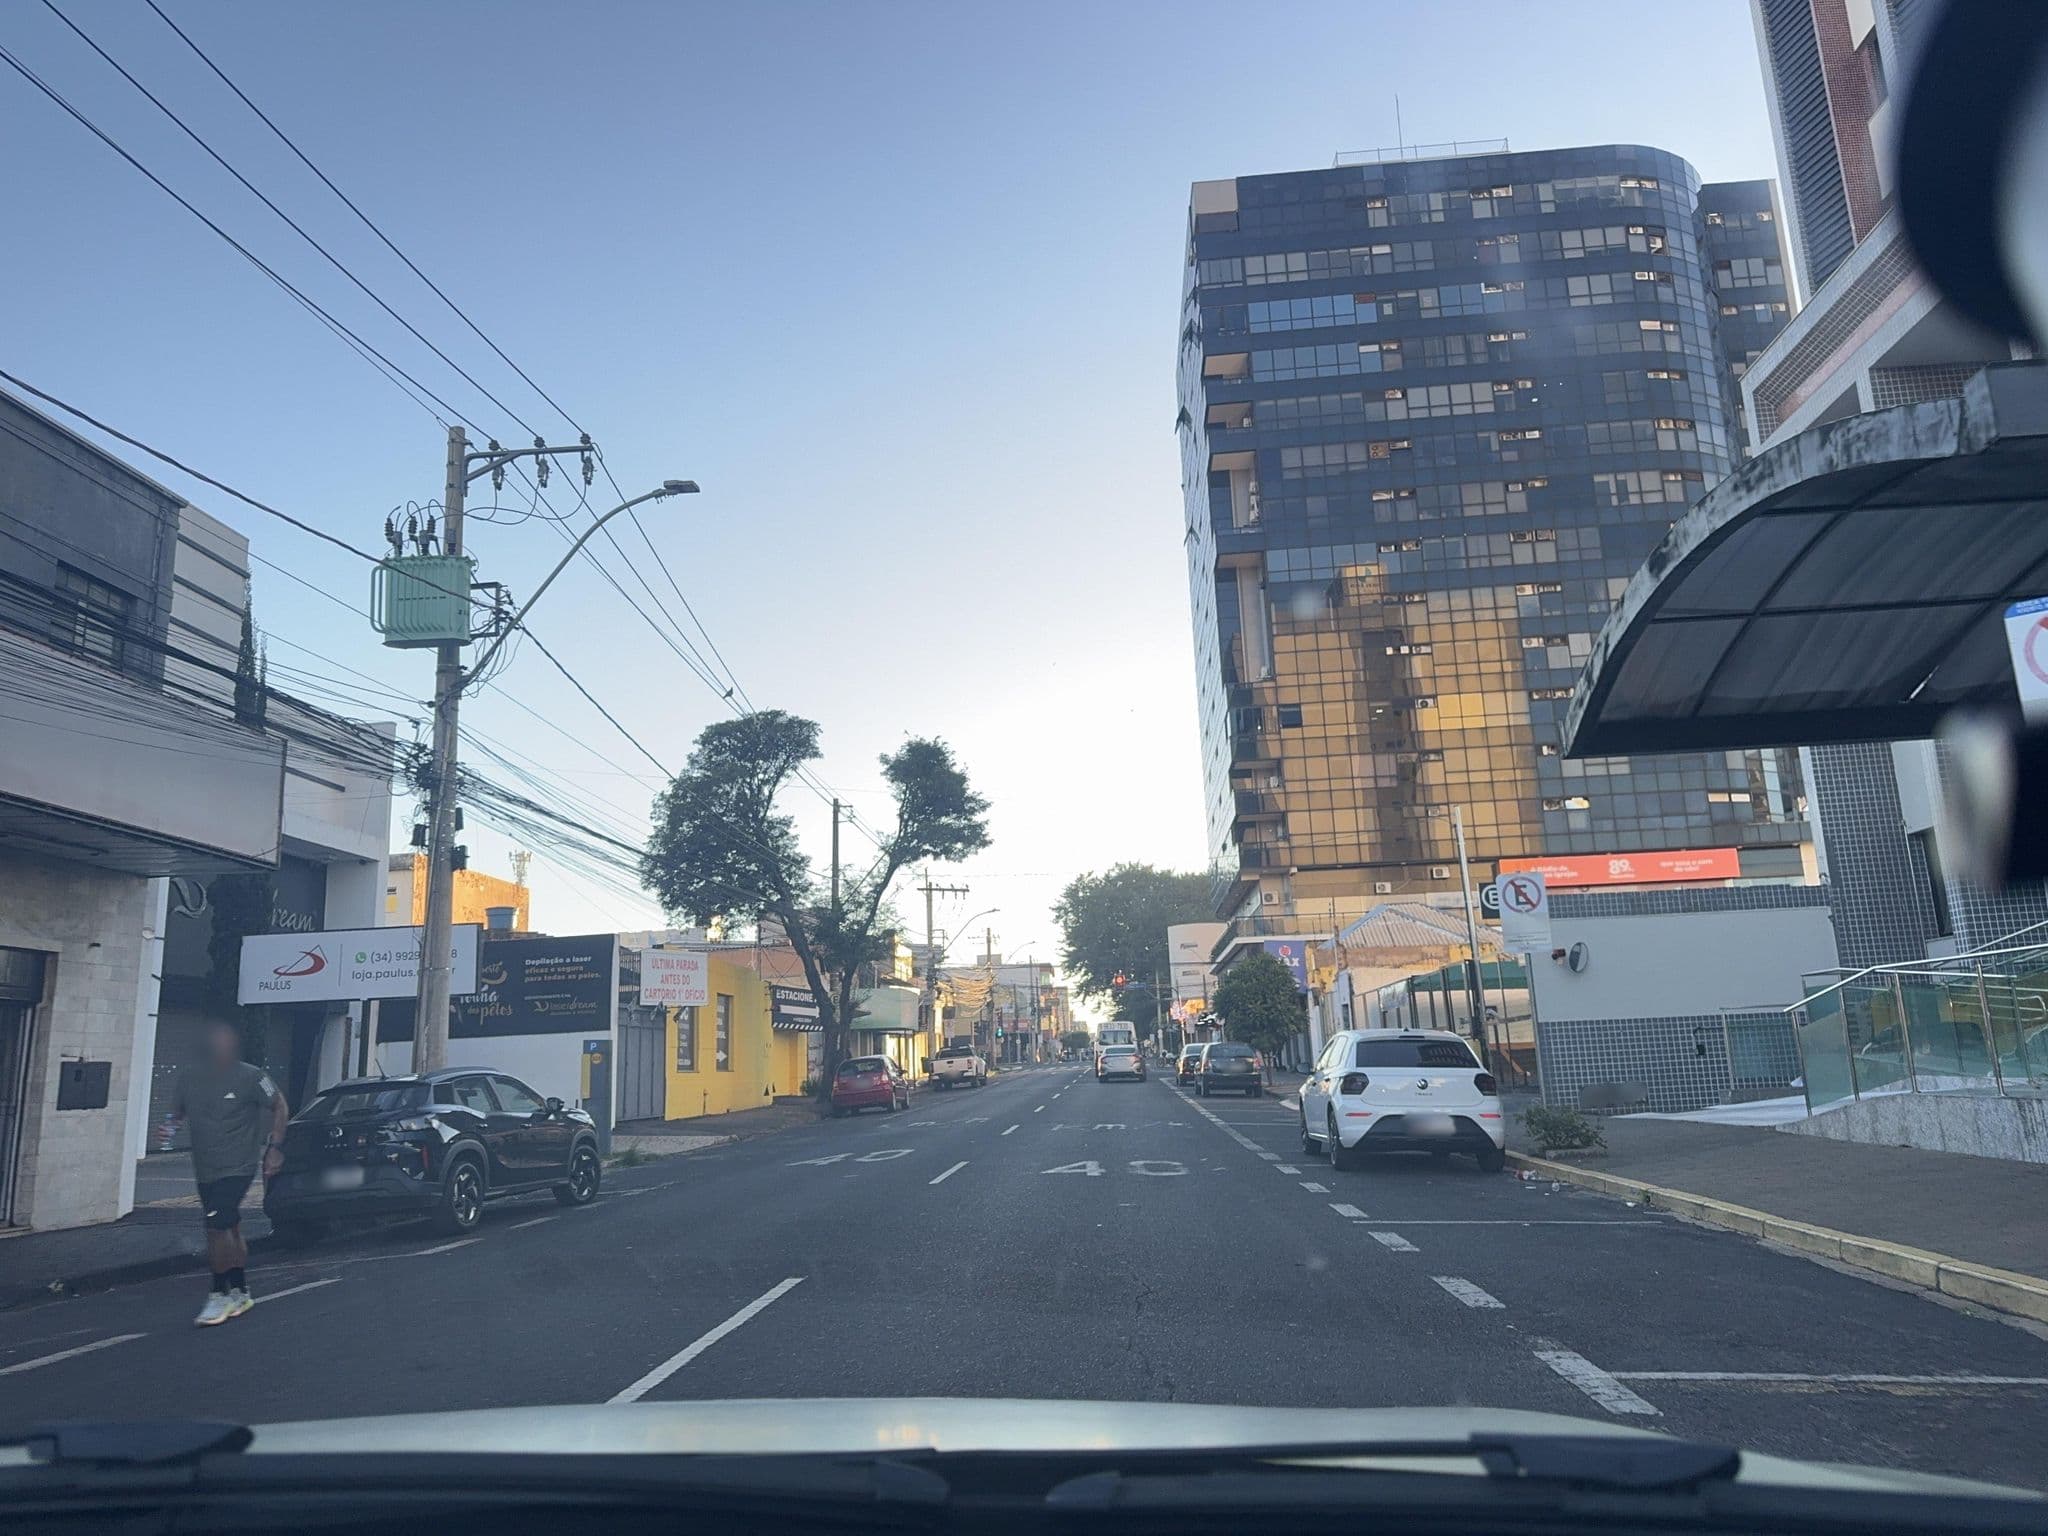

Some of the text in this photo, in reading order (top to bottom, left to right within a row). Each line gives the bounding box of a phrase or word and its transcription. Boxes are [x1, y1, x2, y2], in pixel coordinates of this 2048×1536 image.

[370, 950, 393, 964] (34)
[525, 957, 564, 966] Depilação
[259, 980, 291, 990] PAULUS
[660, 974, 690, 985] ANTES DO
[776, 989, 813, 1003] ESTACIONE
[590, 1042, 597, 1050] P
[1040, 1160, 1190, 1177] 40
